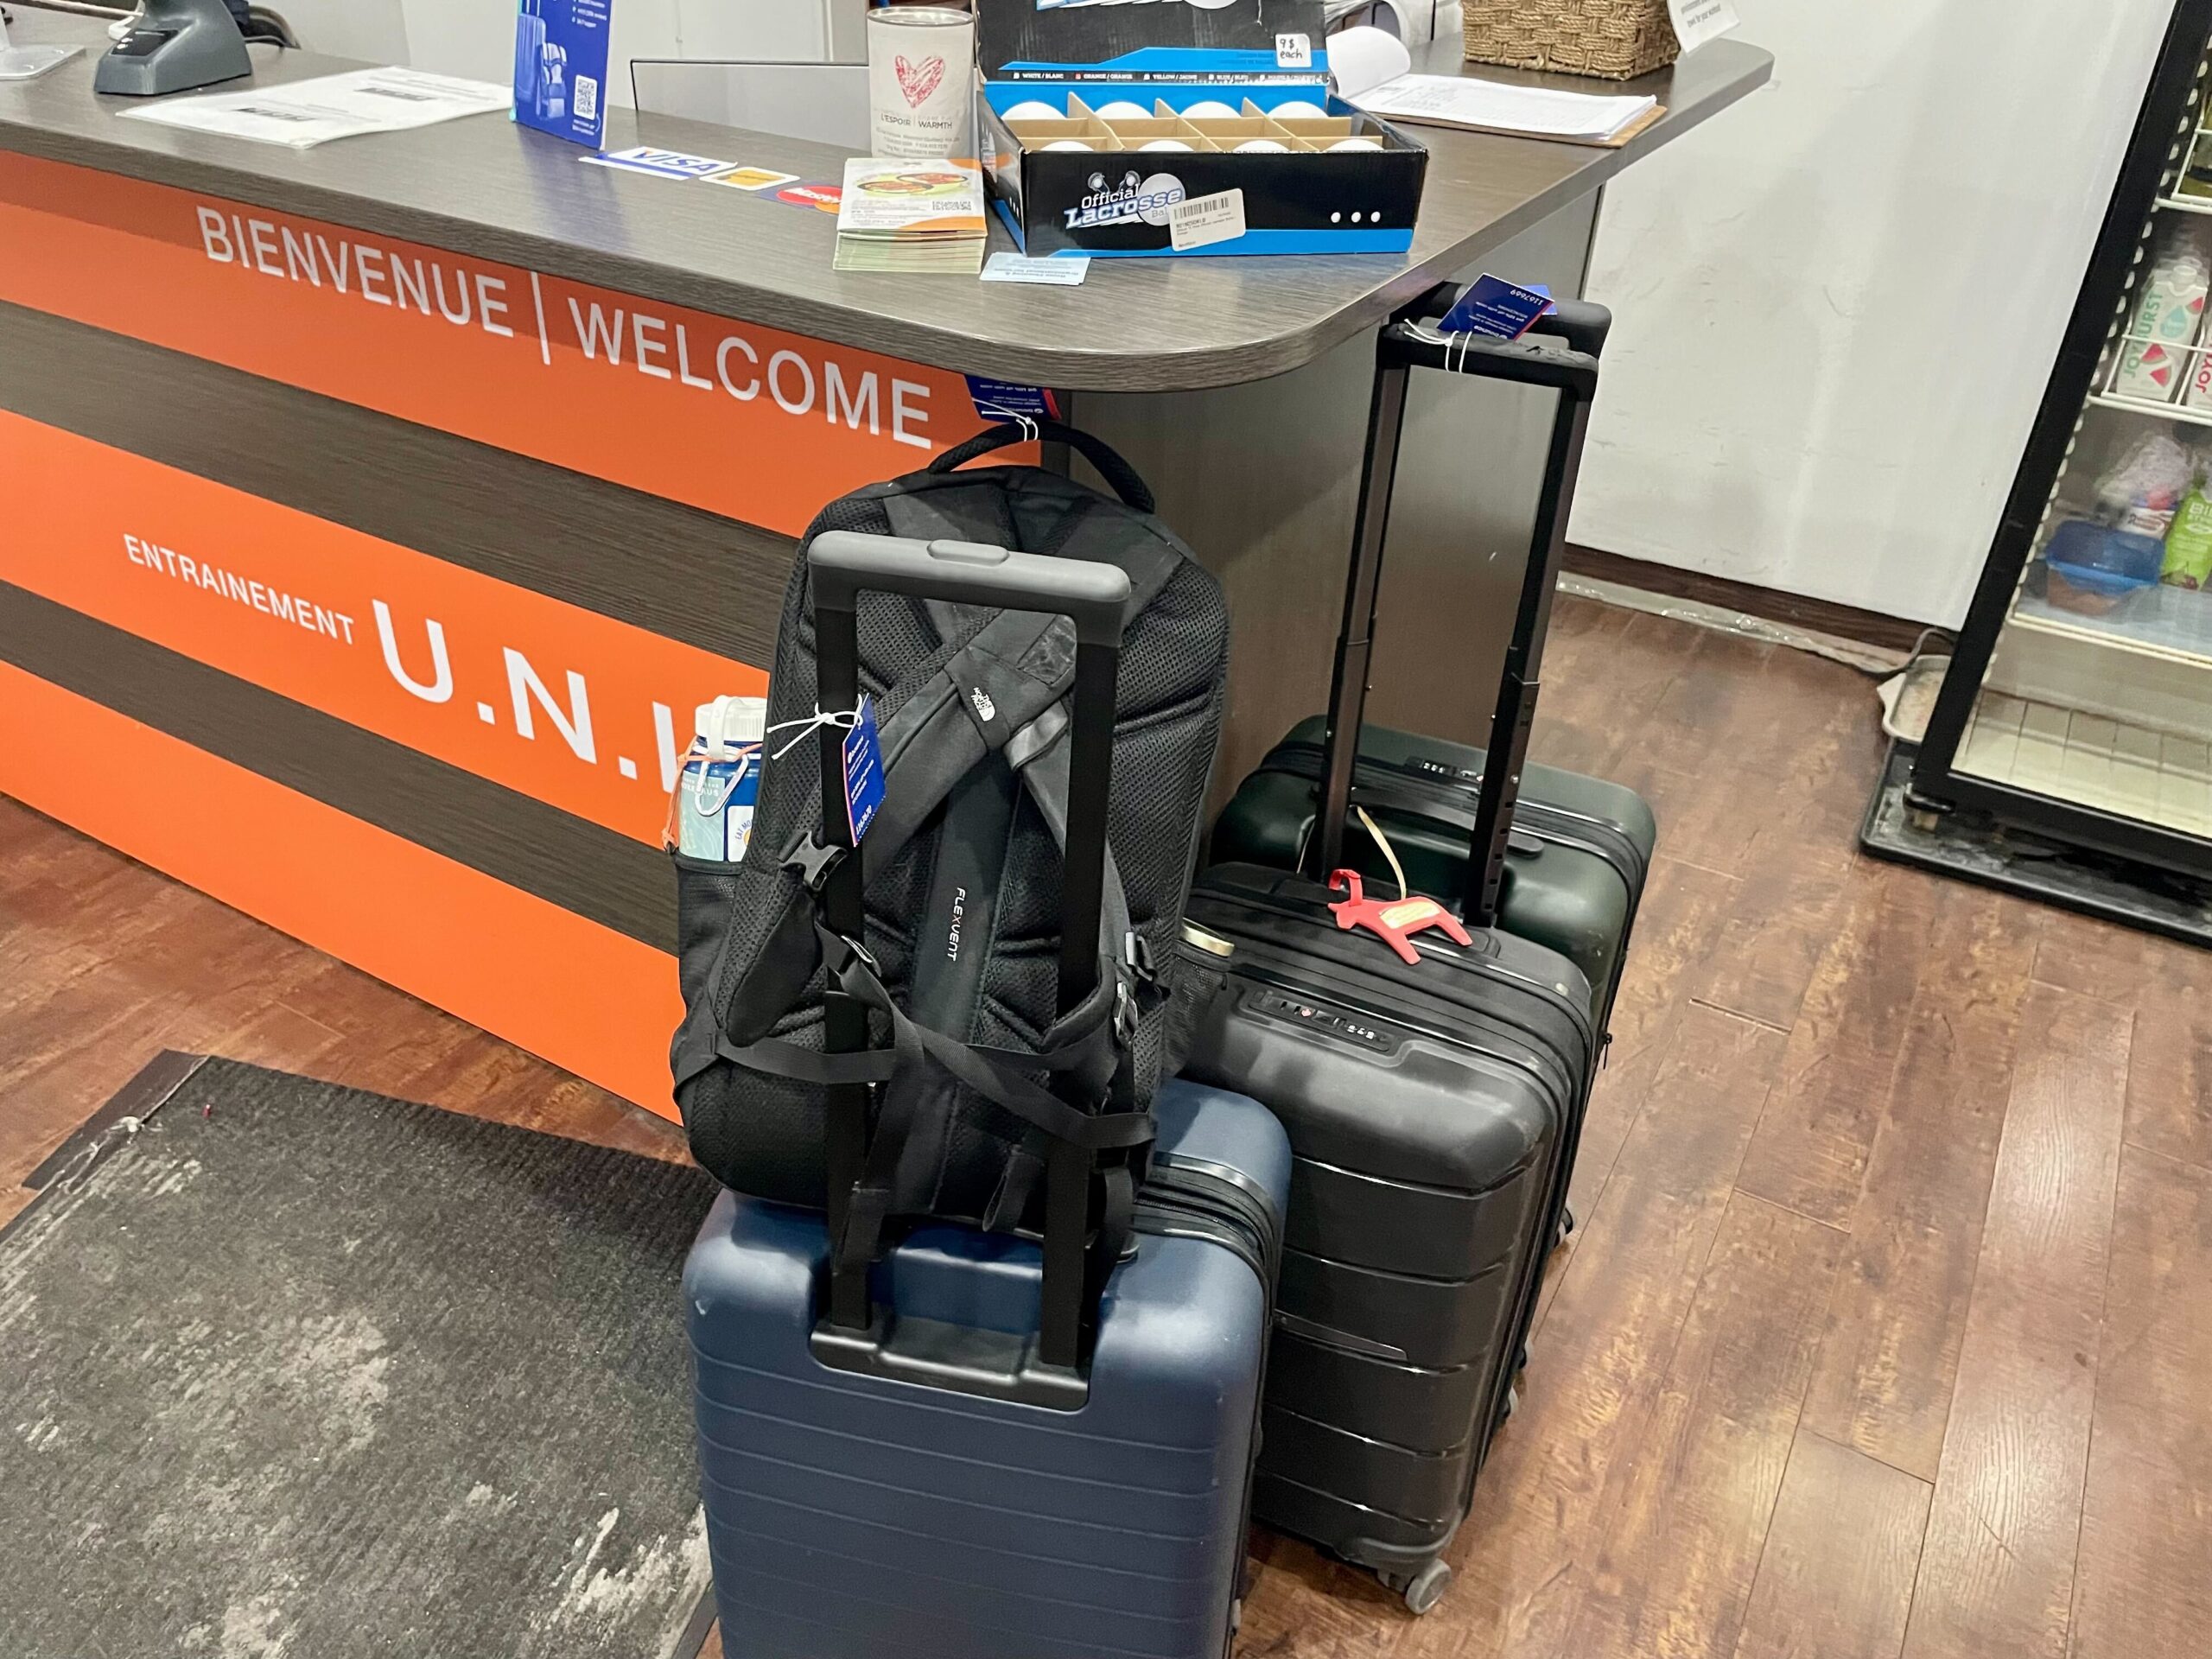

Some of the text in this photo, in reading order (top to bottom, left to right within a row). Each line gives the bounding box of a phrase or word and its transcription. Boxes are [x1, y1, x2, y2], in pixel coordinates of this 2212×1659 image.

[1280, 48, 1302, 59] each
[918, 120, 953, 130] WARMTH
[632, 150, 720, 172] VISA
[1081, 184, 1140, 209] Official
[1064, 188, 1183, 230] Lacrosse
[1510, 288, 1545, 307] 1167669
[196, 206, 933, 449] BIENVENUE WELCOME
[124, 533, 354, 645] ENTRAINEMENT
[735, 829, 745, 841] EAT
[948, 887, 965, 962] FLEXVENT
